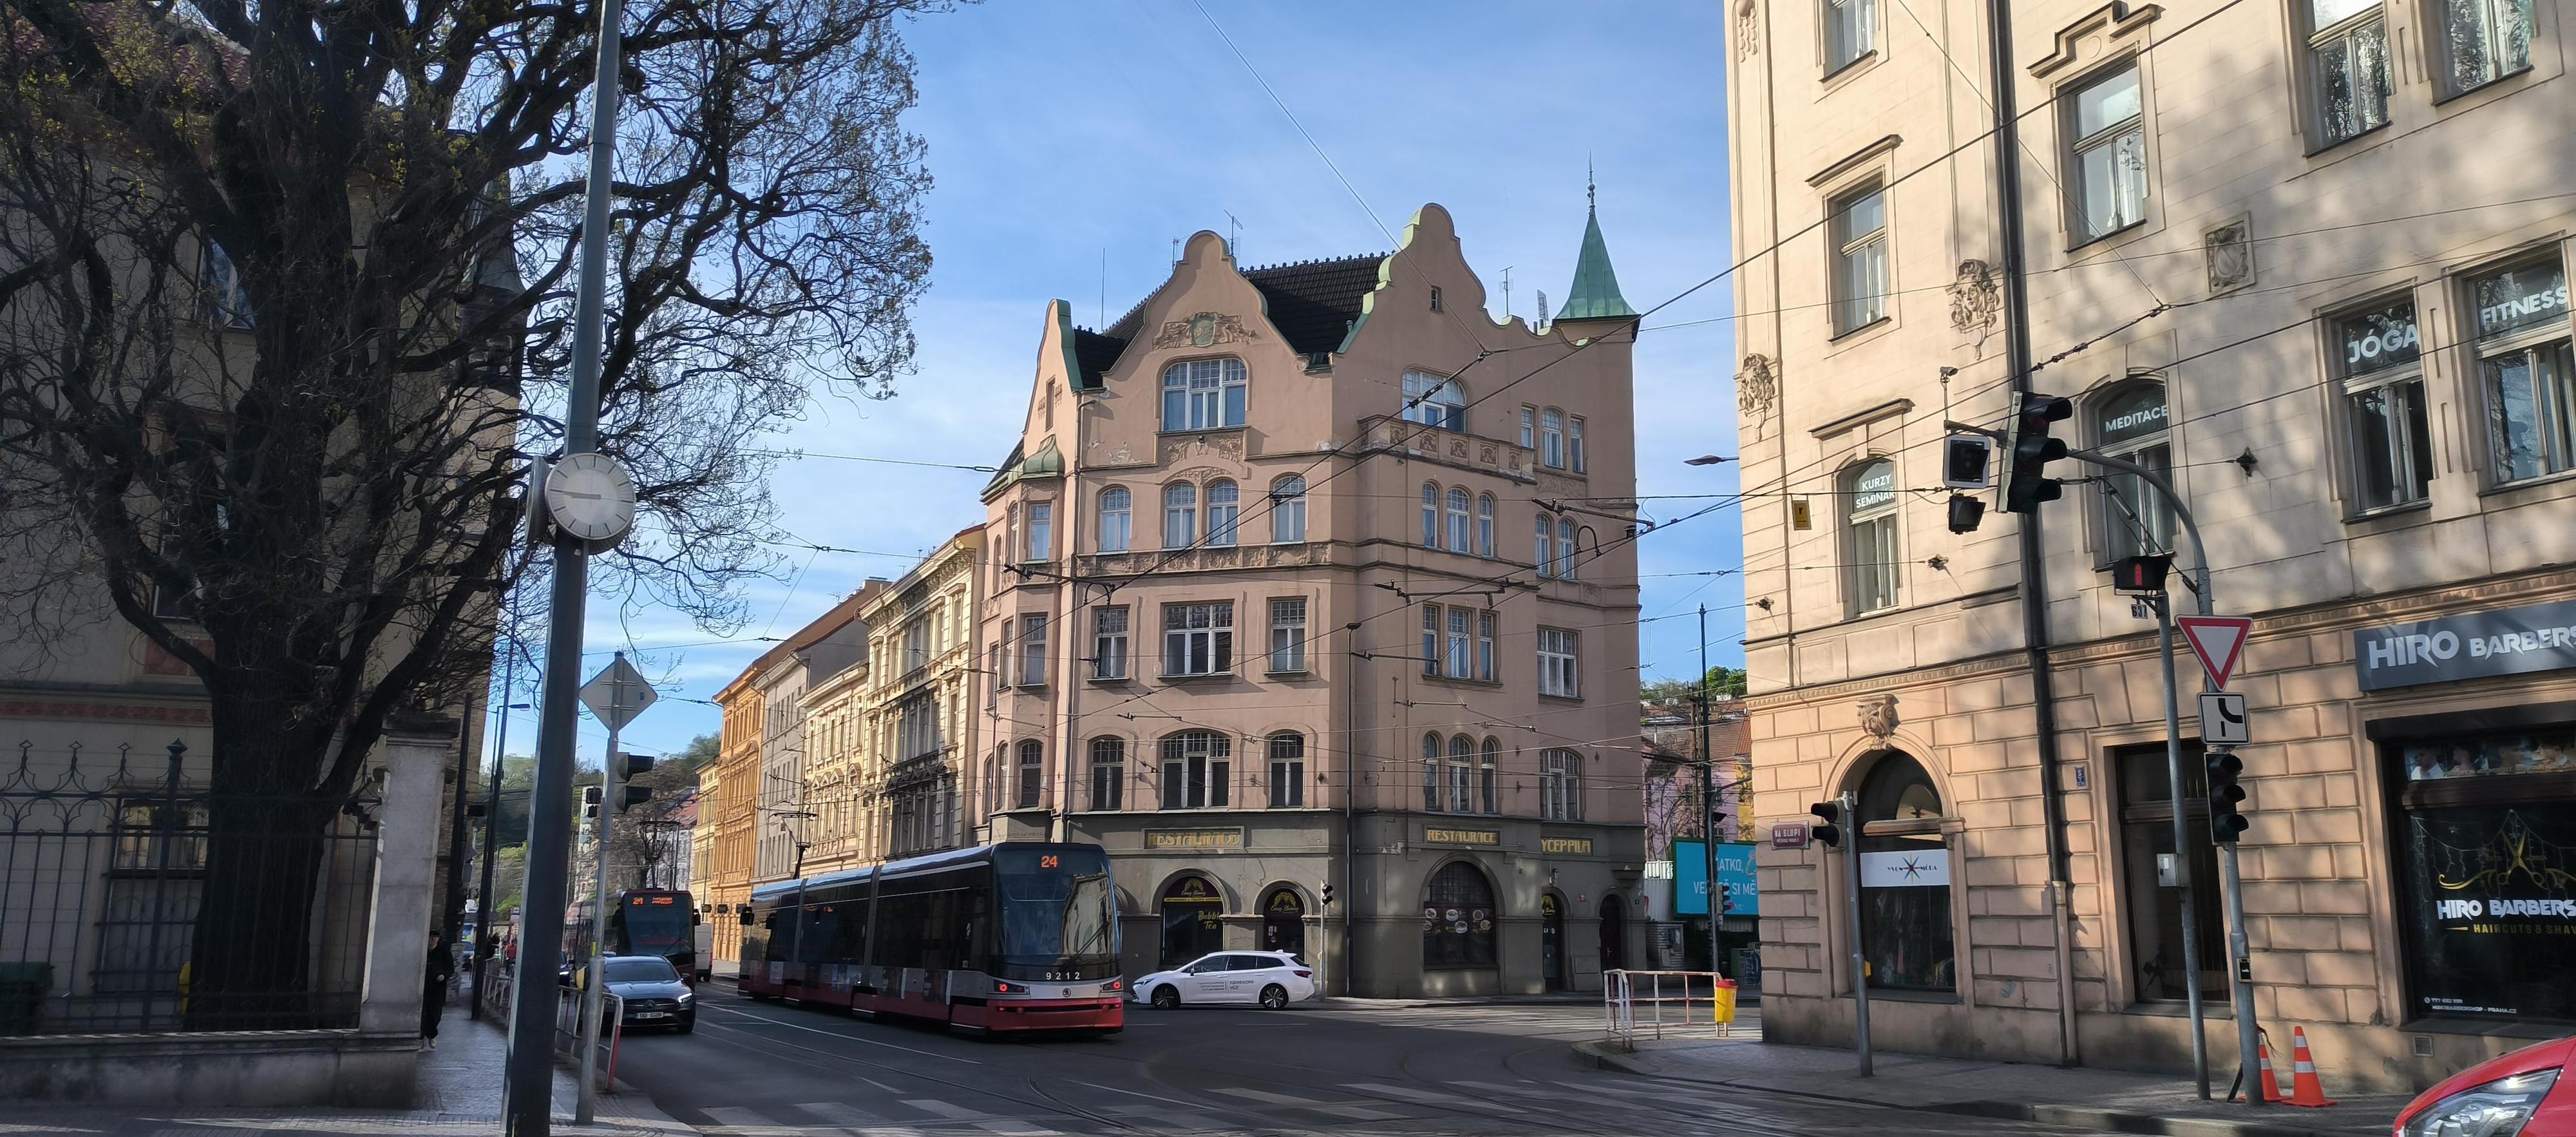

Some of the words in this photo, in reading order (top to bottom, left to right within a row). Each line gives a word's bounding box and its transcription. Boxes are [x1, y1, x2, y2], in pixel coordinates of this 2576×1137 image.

[2482, 287, 2568, 325] FITNESS
[2348, 324, 2420, 363] JÓGA
[2105, 405, 2168, 432] MEDITACE
[1862, 473, 1891, 491] KURZY
[2132, 606, 2146, 617] 637
[2367, 630, 2459, 669] HIRO
[1427, 830, 1496, 843] RESTAURACE
[1783, 828, 1801, 837] SLUPI
[1041, 855, 1057, 868] 24
[1732, 883, 1740, 895] SI
[2436, 899, 2483, 921] HIRO
[2488, 899, 2576, 920] BARBERS
[1204, 921, 1217, 930] Tea
[2474, 924, 2532, 933] HAIRCUTS
